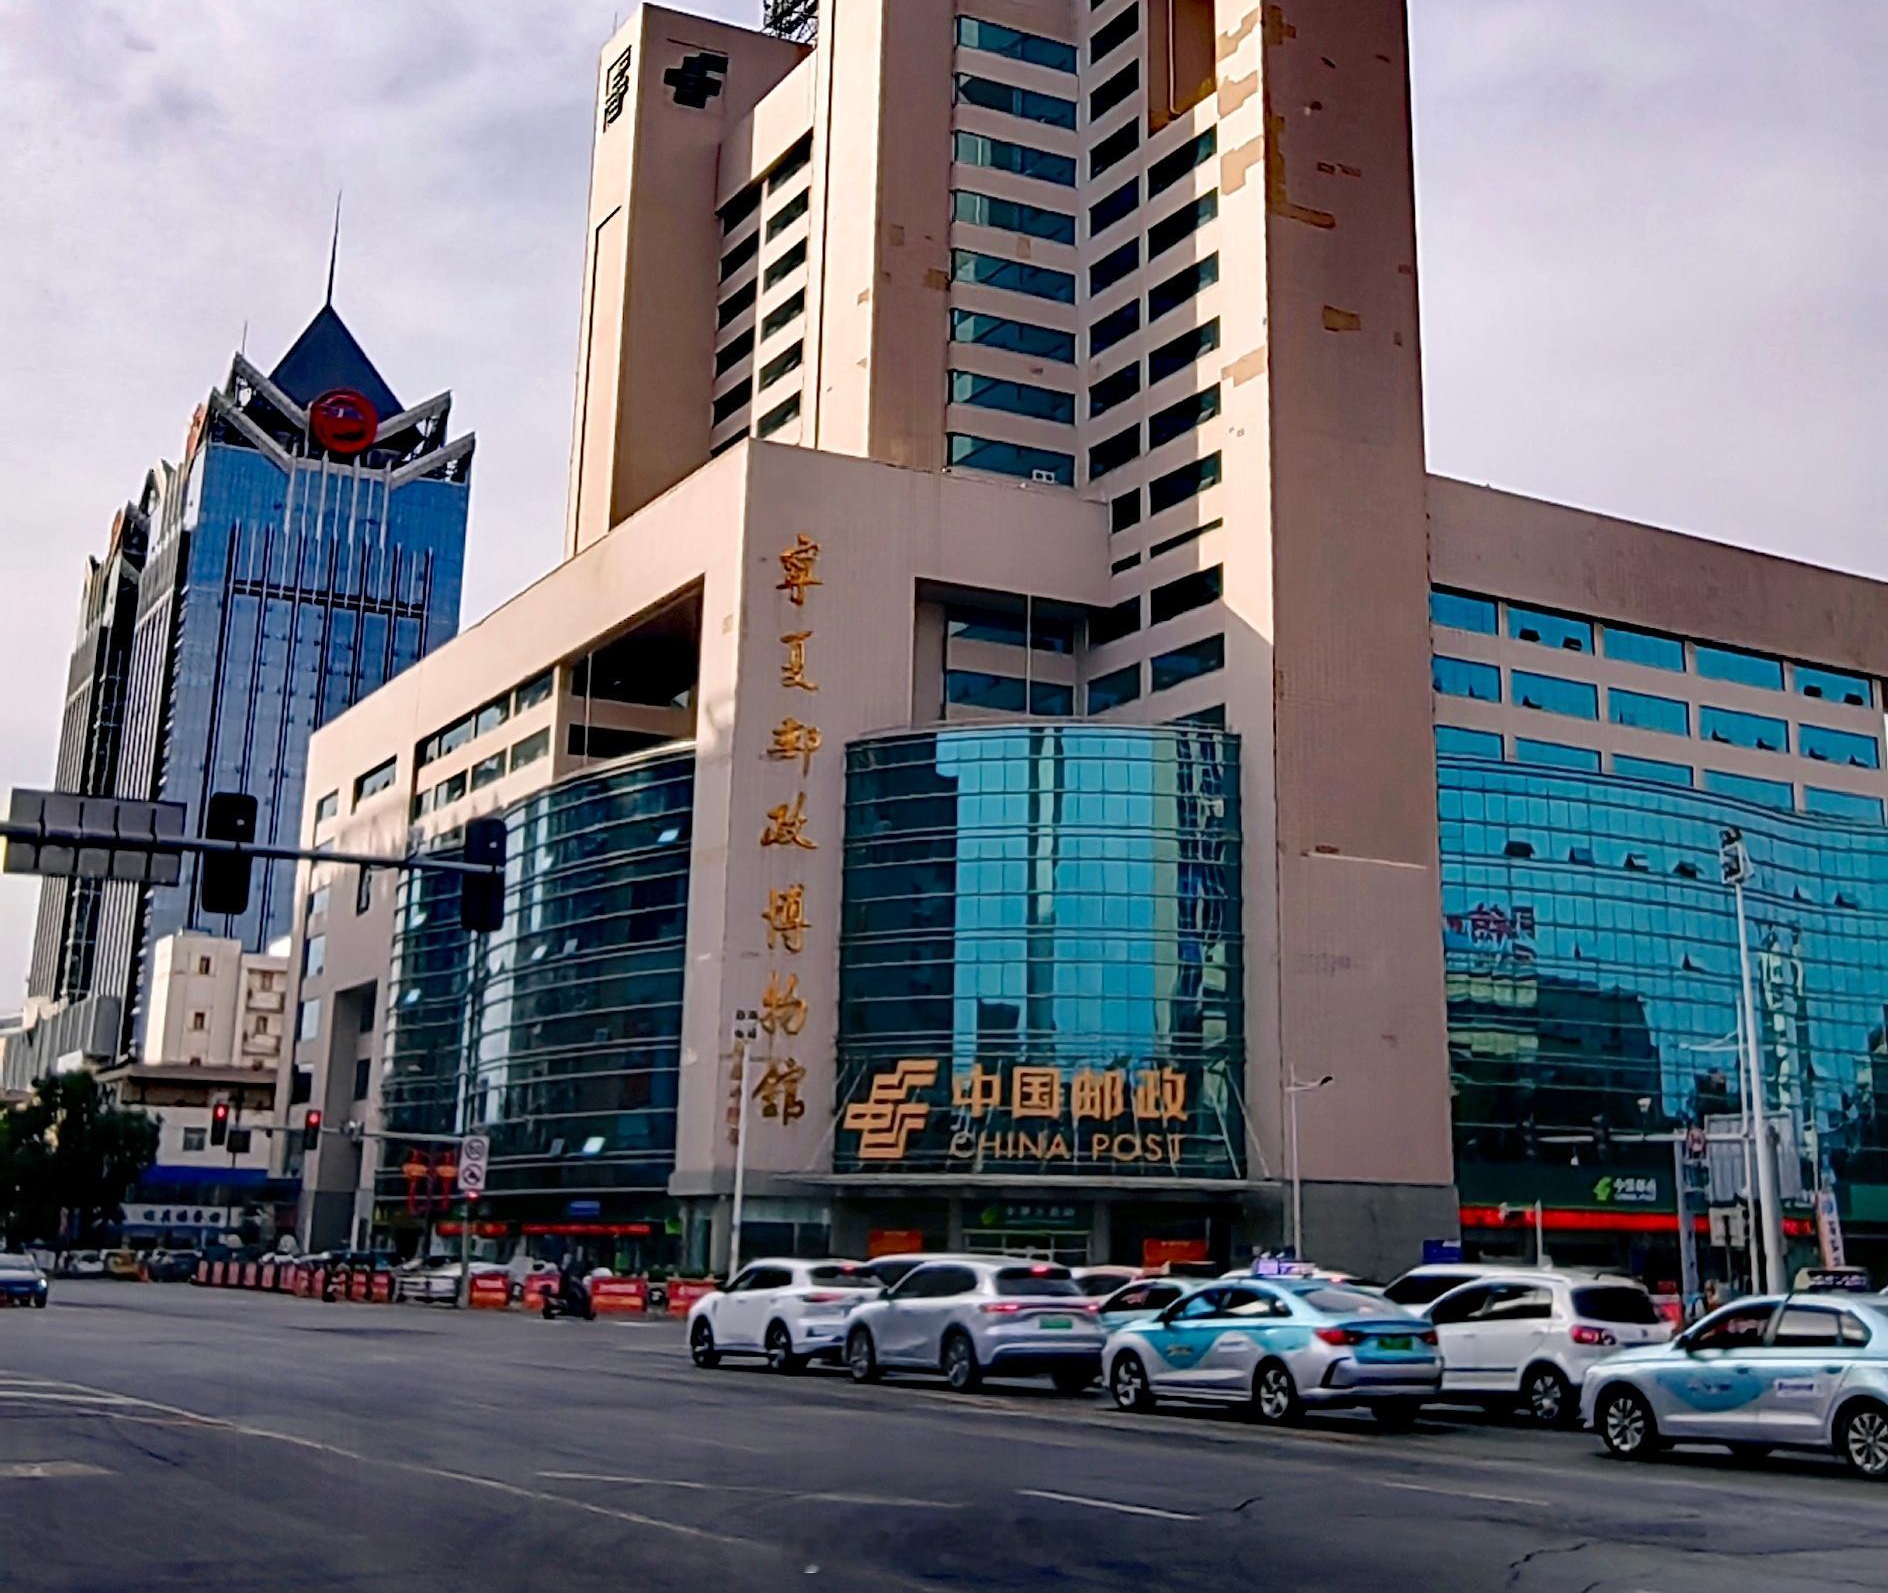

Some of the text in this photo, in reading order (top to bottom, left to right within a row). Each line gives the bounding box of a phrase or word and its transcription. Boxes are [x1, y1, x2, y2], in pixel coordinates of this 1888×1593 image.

[952, 1062, 1187, 1121] 中国邮政
[950, 1131, 1187, 1162] CHINA POST
